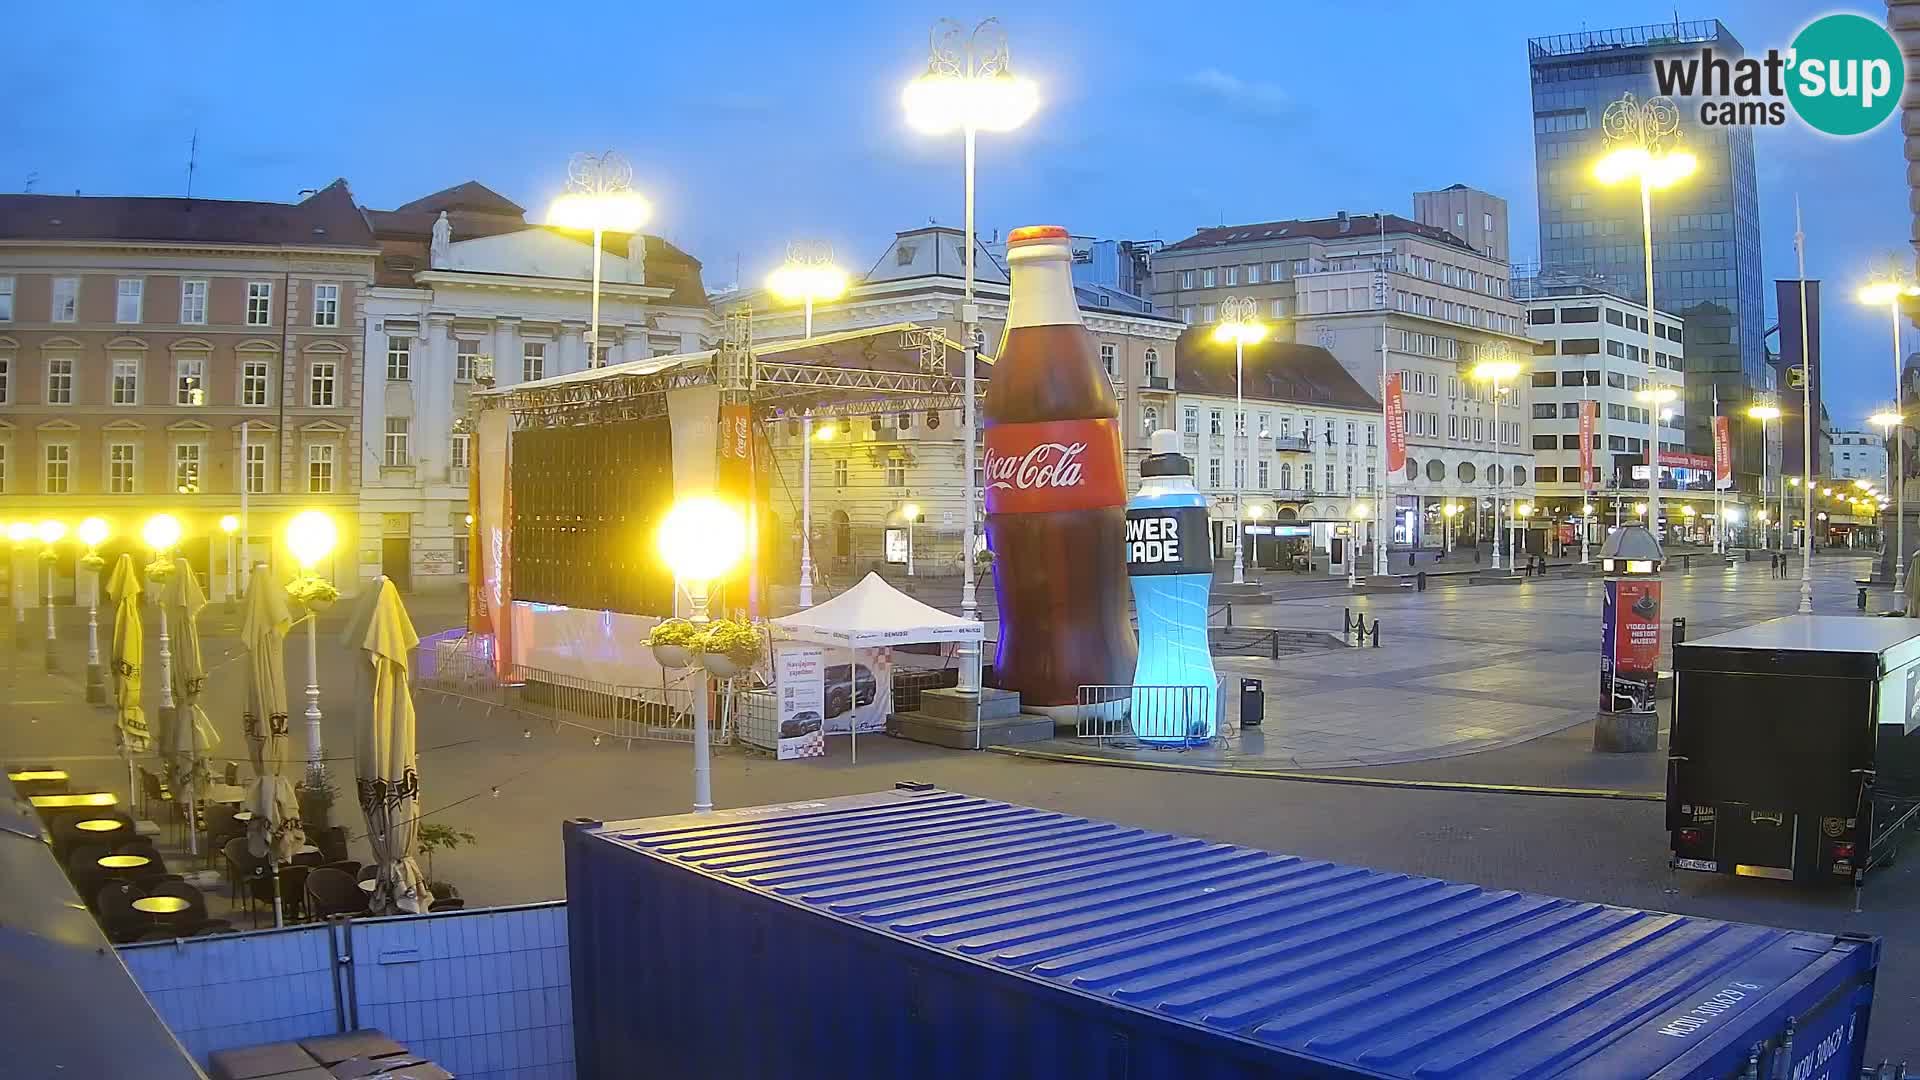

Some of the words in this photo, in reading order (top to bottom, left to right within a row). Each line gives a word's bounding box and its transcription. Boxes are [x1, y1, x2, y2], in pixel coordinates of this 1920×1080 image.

[984, 443, 1087, 489] Coca-Cola
[1658, 1015, 1708, 1038] MCDU
[1691, 989, 1747, 1017] 300629
